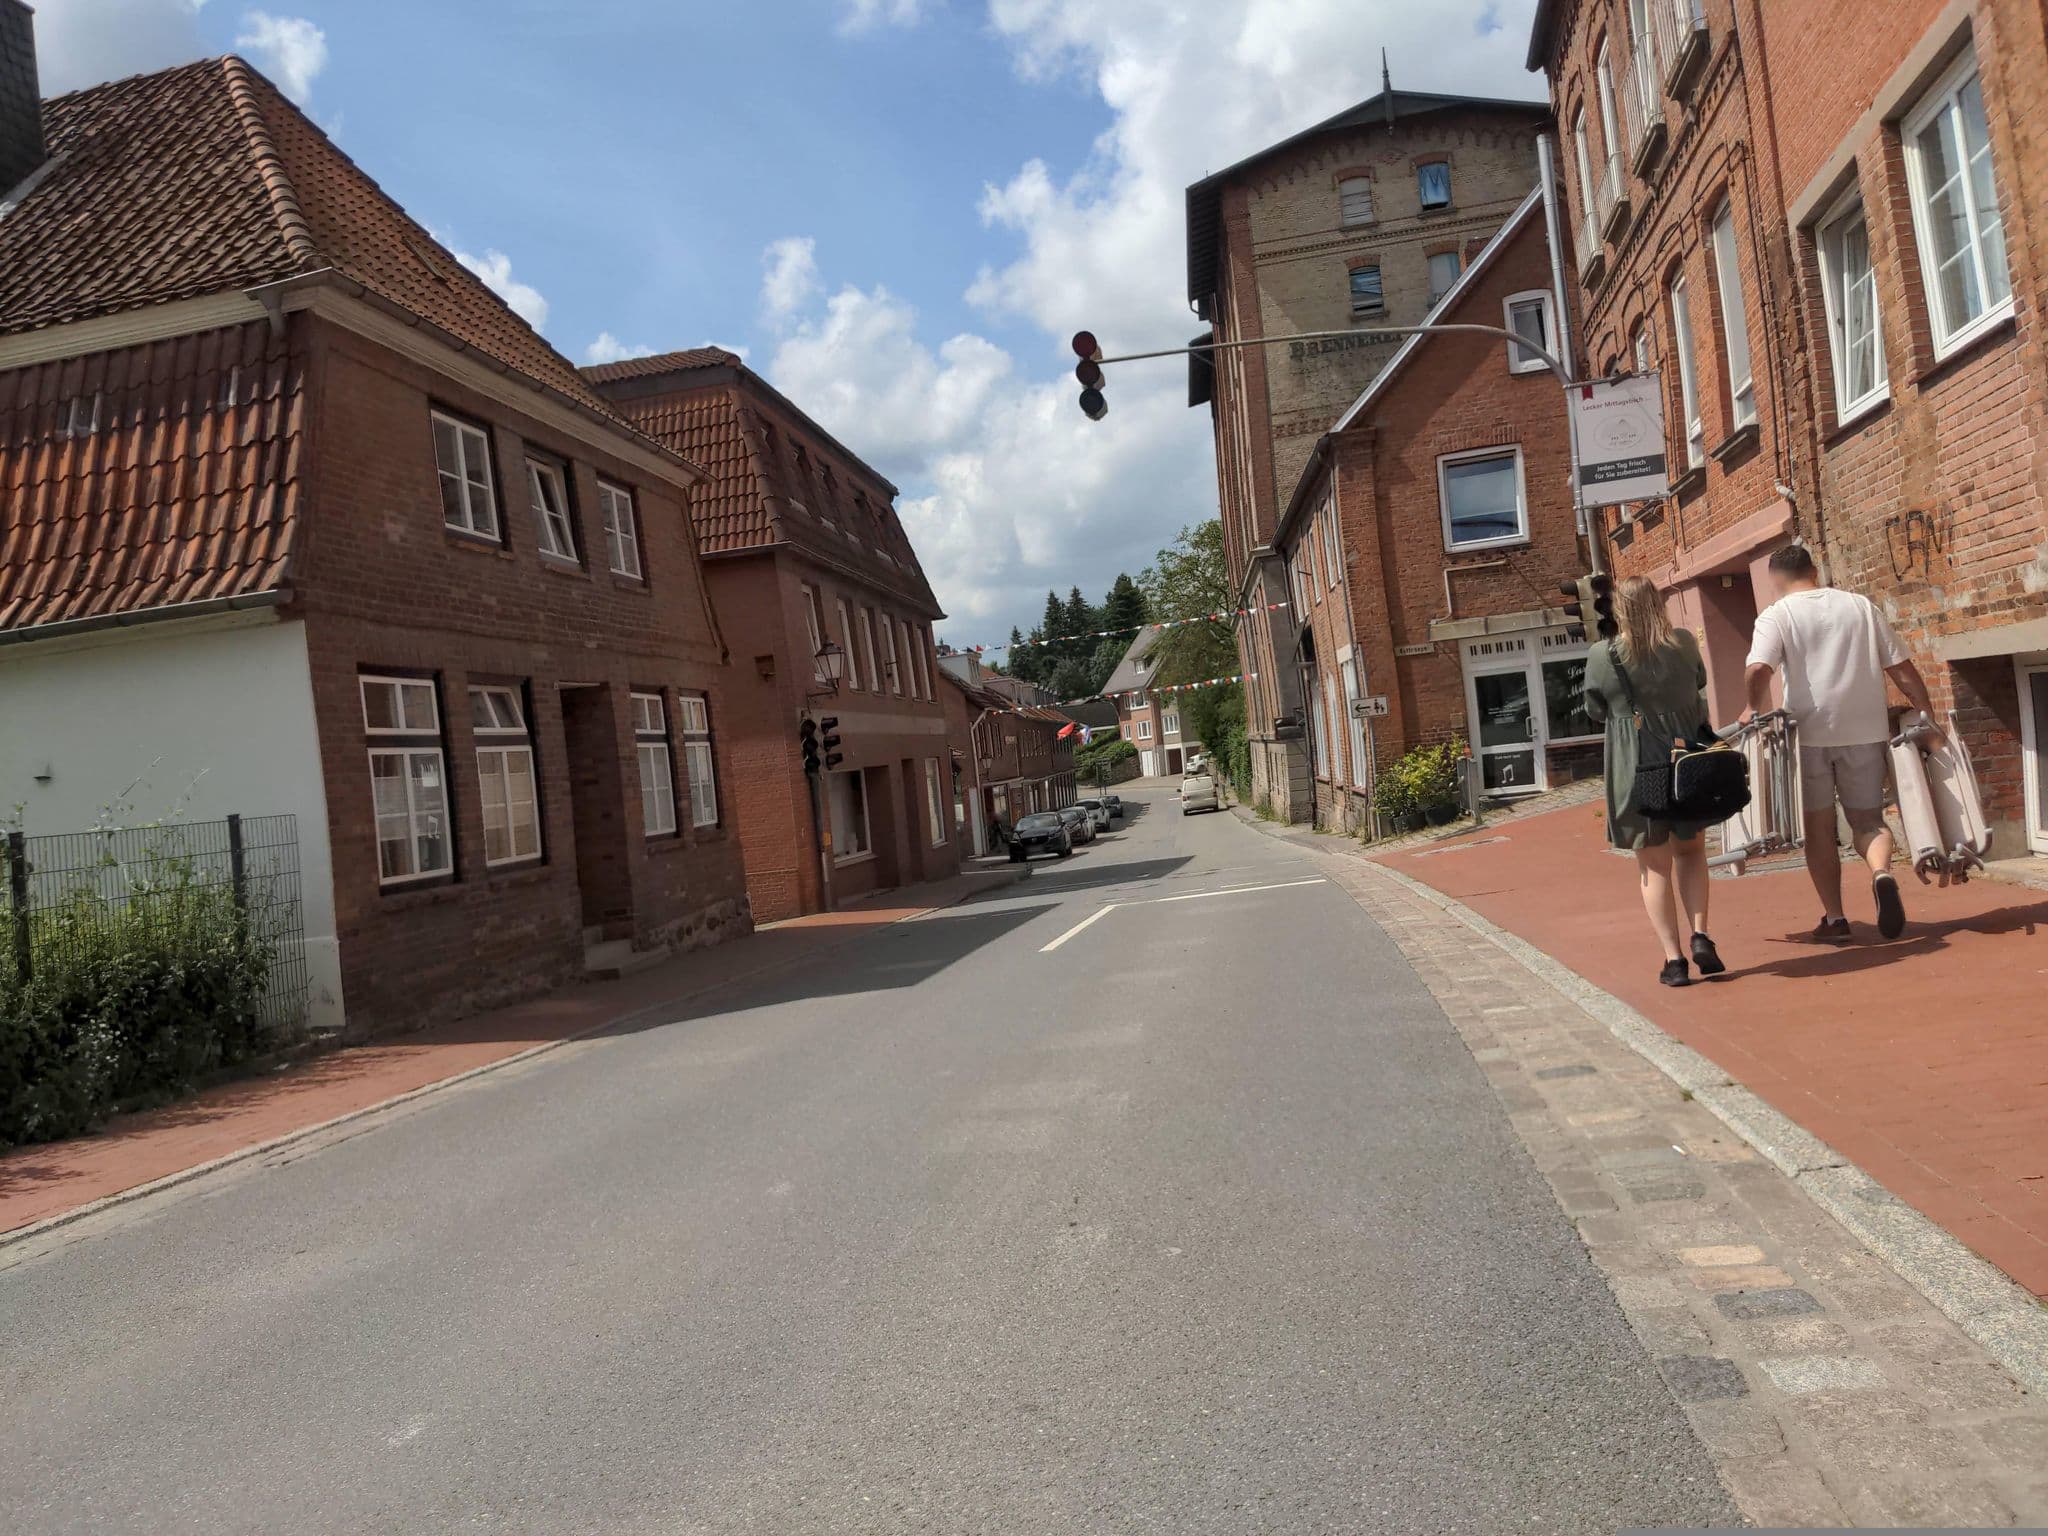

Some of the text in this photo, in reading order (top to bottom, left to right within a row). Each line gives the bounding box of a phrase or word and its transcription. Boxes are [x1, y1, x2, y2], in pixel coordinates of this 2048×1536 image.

[1597, 464, 1616, 472] Jeden
[1628, 459, 1646, 467] frisch
[1616, 465, 1651, 477] zubereitet!
